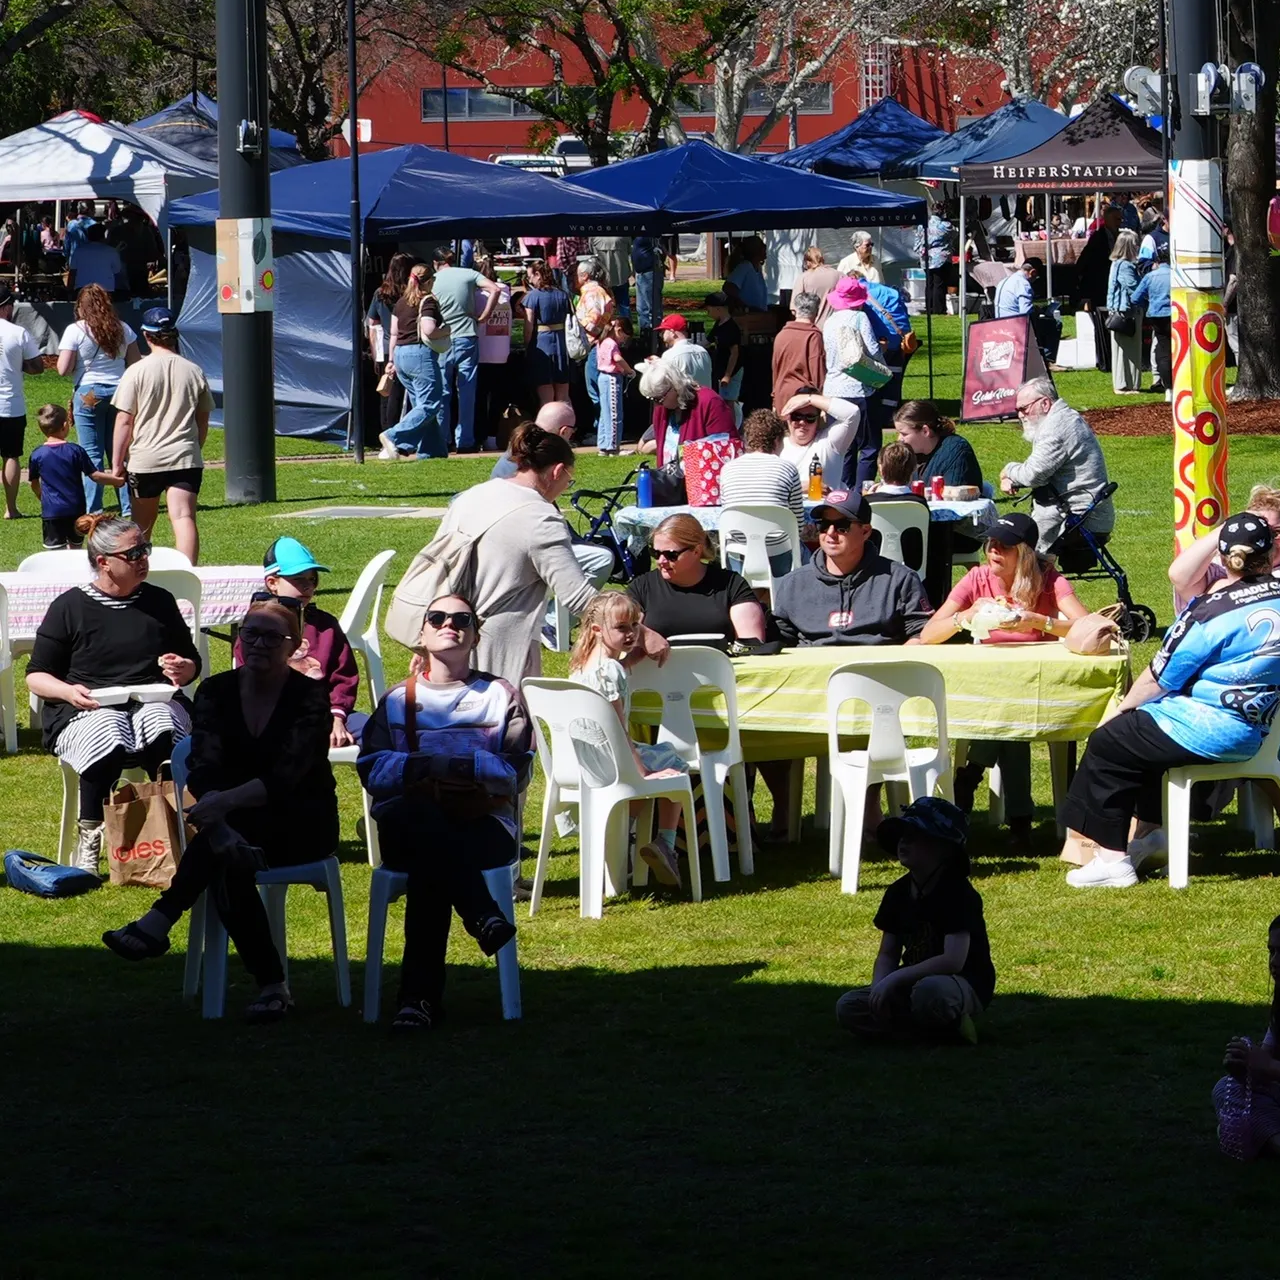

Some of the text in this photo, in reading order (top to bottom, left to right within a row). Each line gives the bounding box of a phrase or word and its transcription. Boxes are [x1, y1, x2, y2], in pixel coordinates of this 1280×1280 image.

[1017, 181, 1114, 190] ORANGE AUSTRALIA
[1229, 584, 1269, 600] DEADLY
